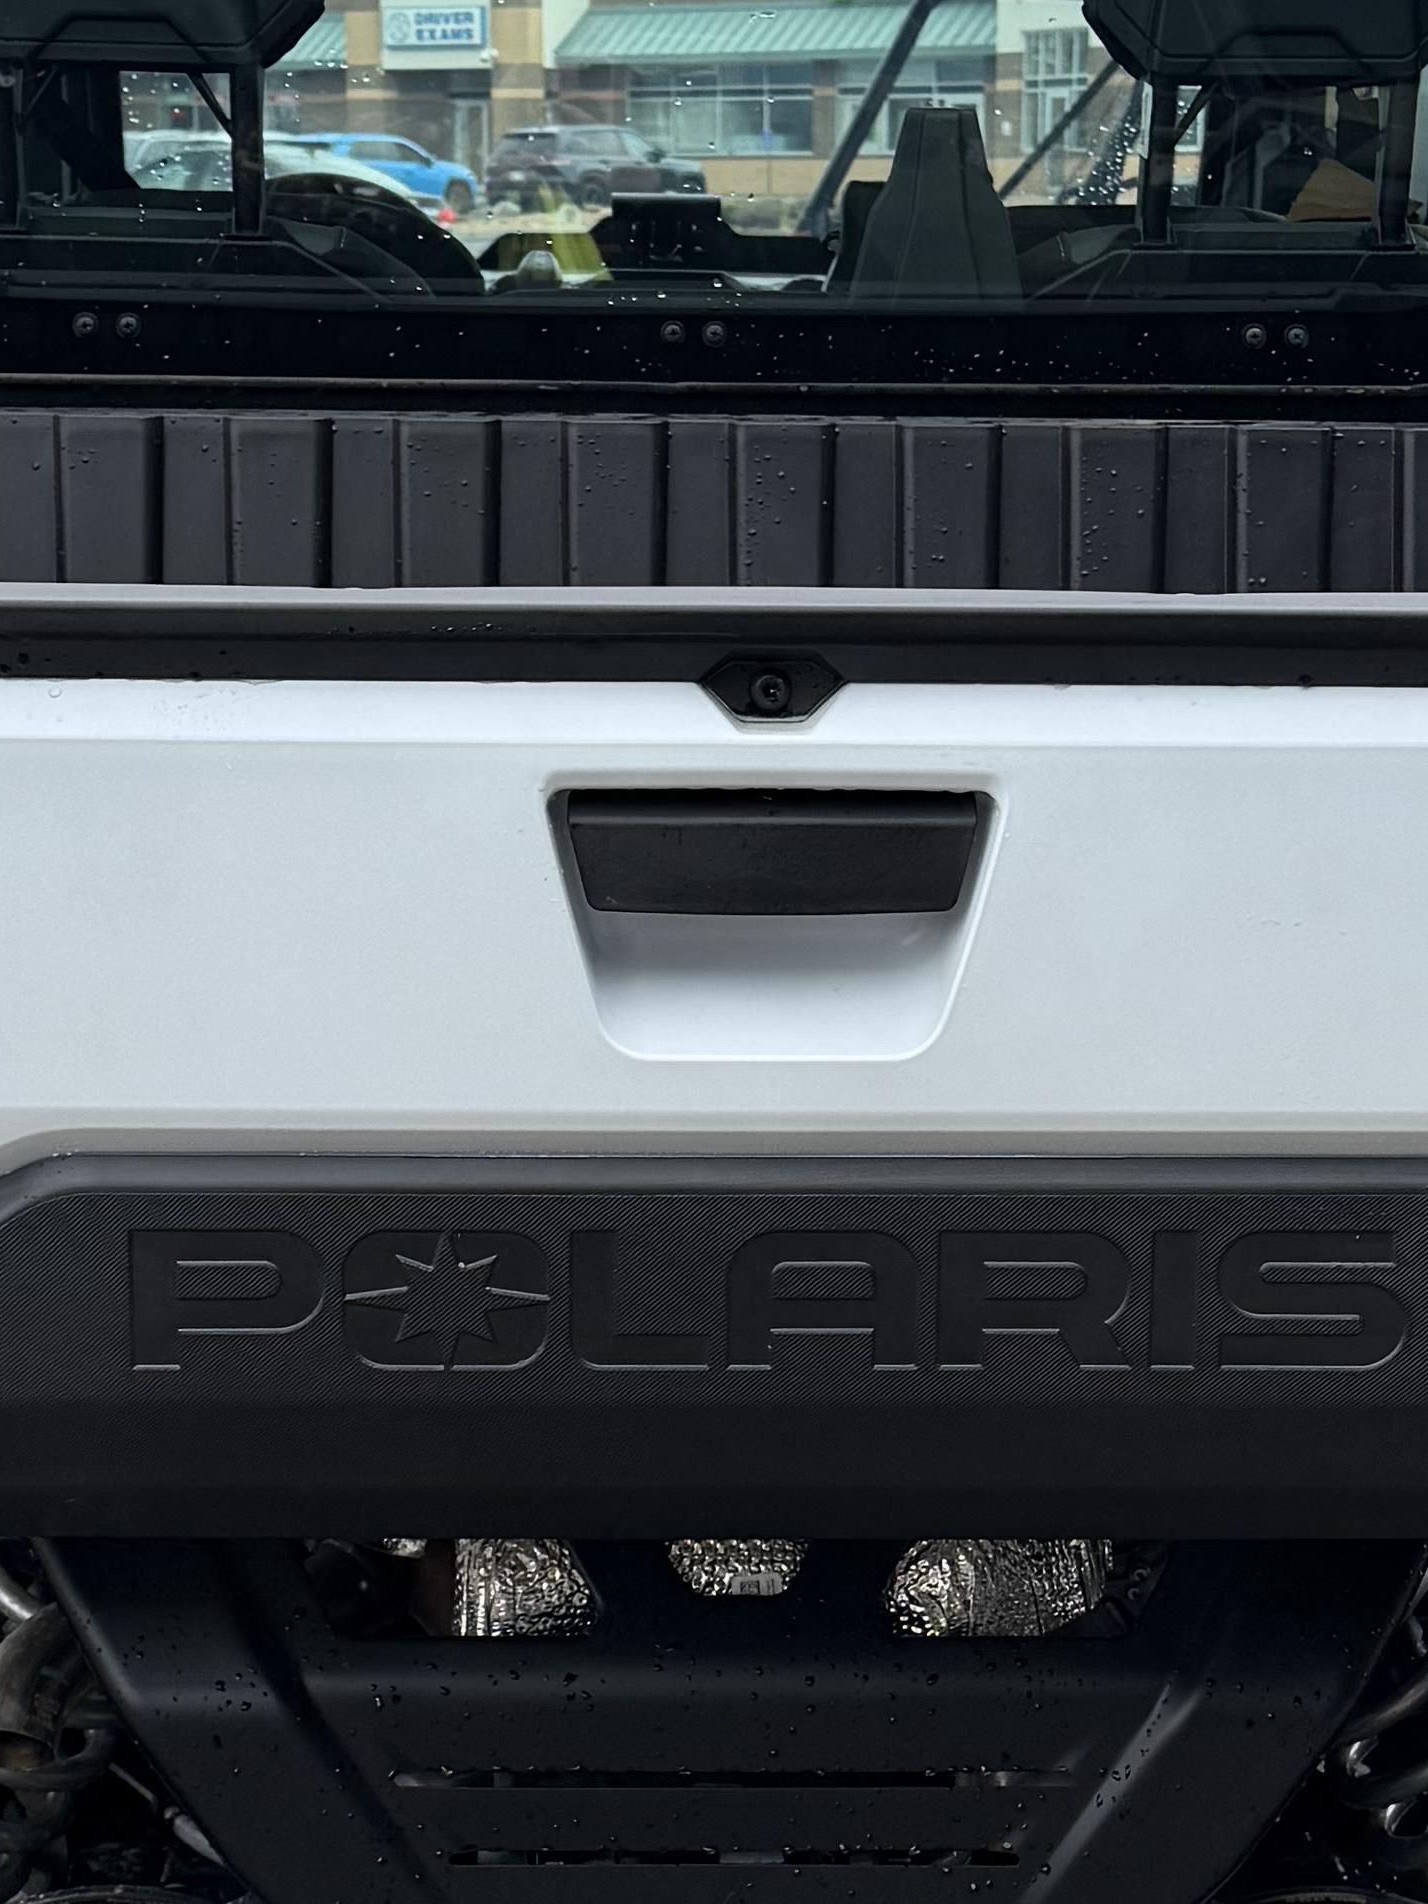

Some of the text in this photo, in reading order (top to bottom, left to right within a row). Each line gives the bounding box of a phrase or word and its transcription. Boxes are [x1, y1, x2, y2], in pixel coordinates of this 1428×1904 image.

[414, 12, 474, 25] DRIVER
[416, 28, 474, 41] EXAMS
[126, 1229, 1411, 1372] POLARIS
